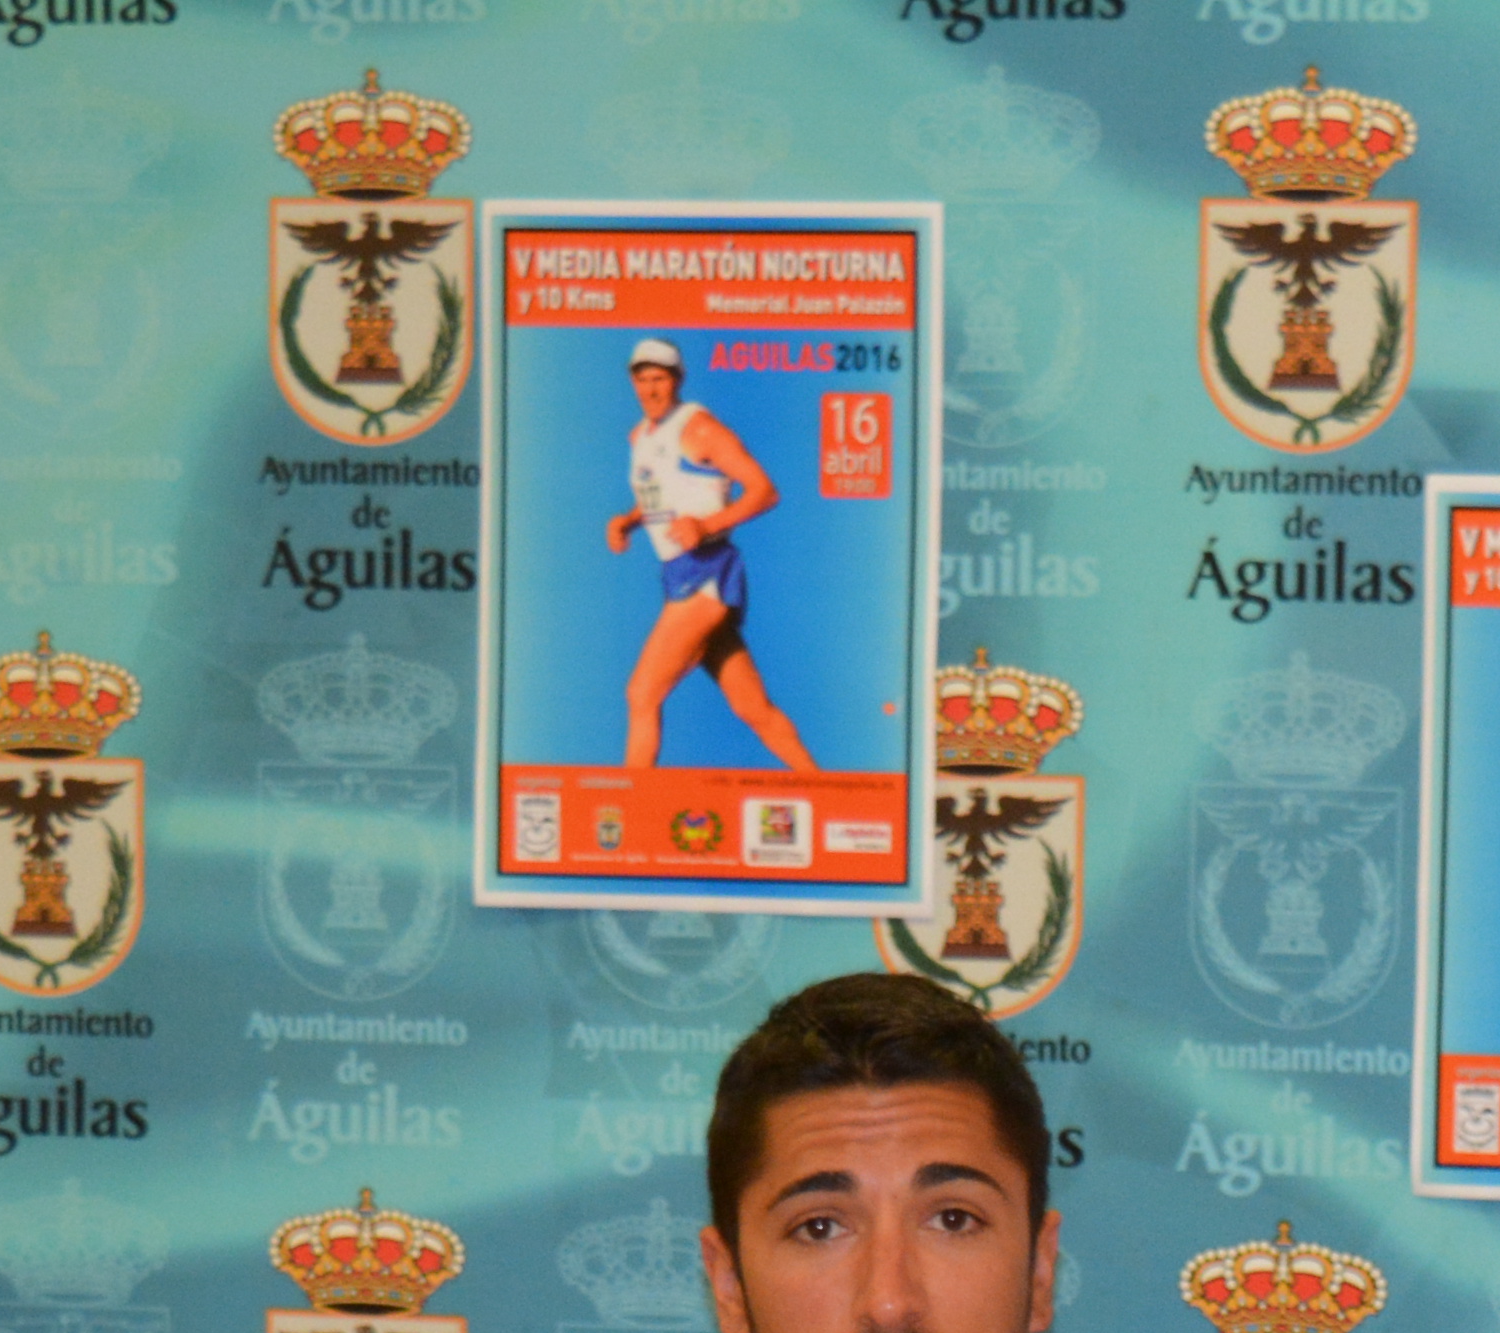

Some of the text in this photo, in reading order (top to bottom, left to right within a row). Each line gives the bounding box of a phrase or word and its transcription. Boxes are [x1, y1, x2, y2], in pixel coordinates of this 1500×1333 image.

[513, 241, 906, 282] V MEDIA MARATÓN NOCTURNA
[518, 287, 616, 314] y 10 Kms
[706, 294, 790, 313] Memorial
[794, 296, 834, 314] Juan
[830, 399, 878, 444] 16
[258, 456, 480, 493] Ayuntamiento
[825, 449, 882, 476] abril
[1183, 464, 1423, 504] Ayuntamiento
[352, 495, 389, 531] de
[1283, 508, 1322, 541] de
[1460, 527, 1481, 558] V
[263, 526, 477, 610] Águilas
[1187, 540, 1415, 624] Águilas
[1464, 571, 1480, 594] y
[244, 1010, 468, 1047] Ayuntamiento
[27, 1047, 64, 1078] de
[336, 1053, 376, 1085] de
[247, 1085, 462, 1163] Águilas
